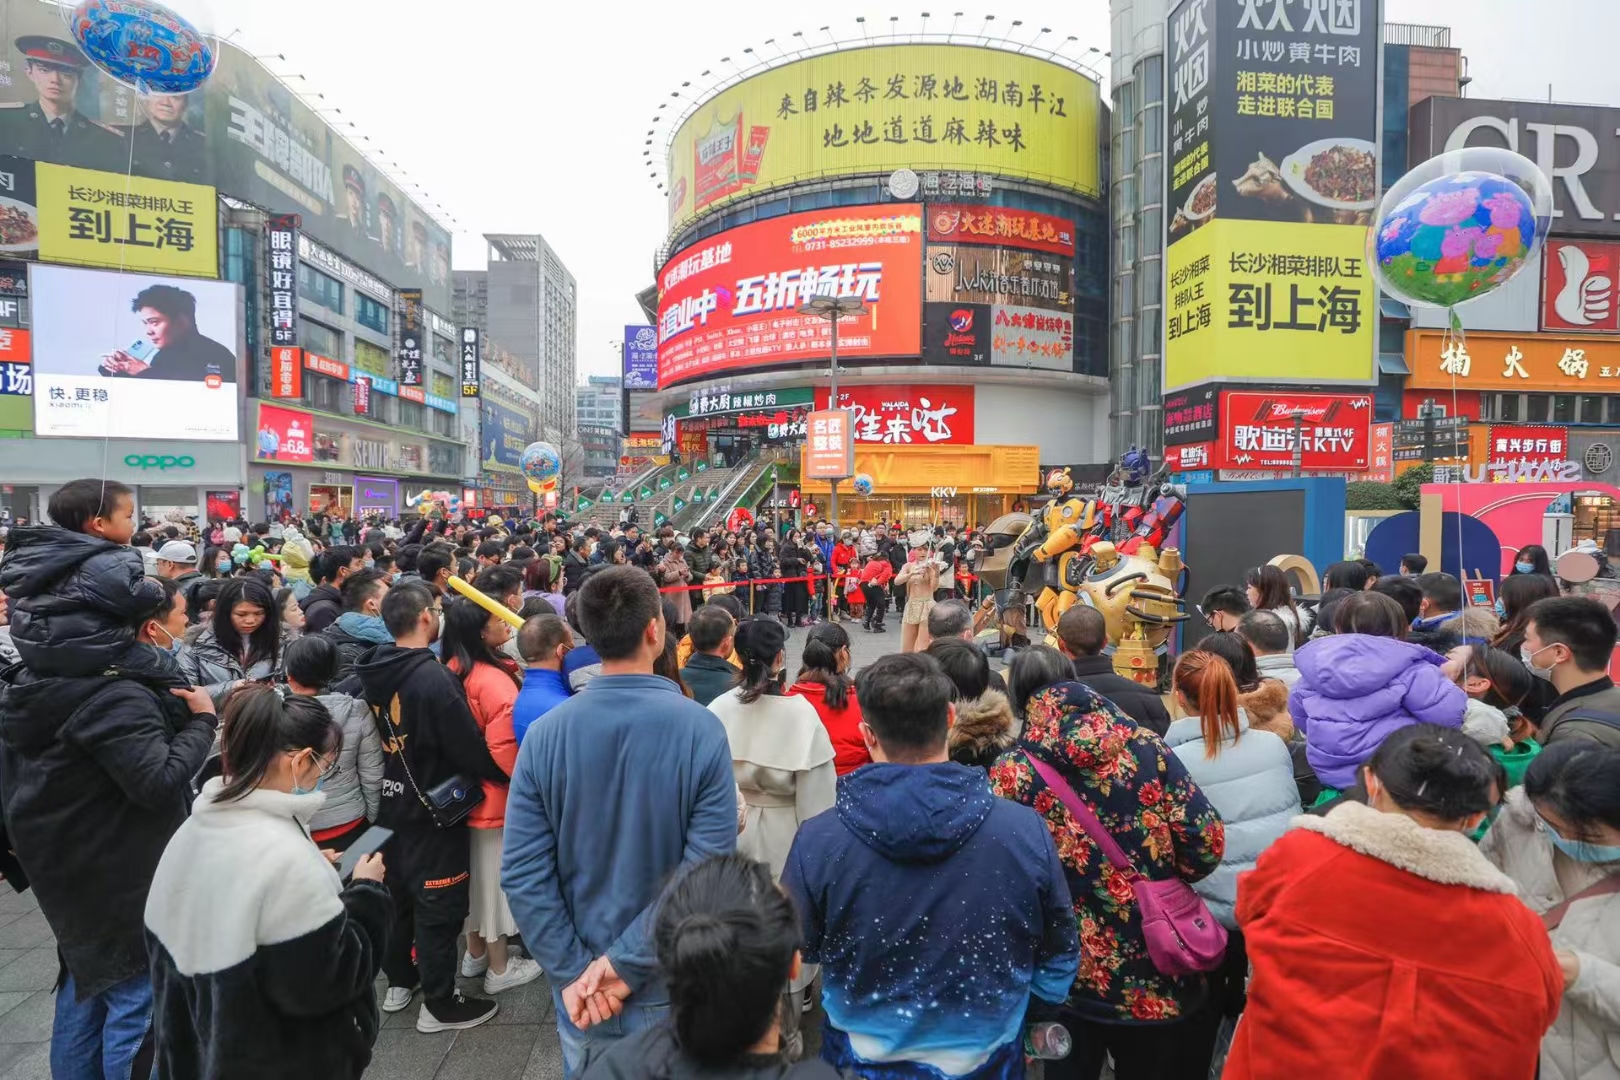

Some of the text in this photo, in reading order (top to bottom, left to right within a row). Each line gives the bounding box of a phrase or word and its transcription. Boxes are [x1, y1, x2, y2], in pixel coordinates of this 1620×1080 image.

[1236, 0, 1361, 36] 炊烟
[1236, 38, 1361, 67] 小炒黄牛肉
[776, 74, 1068, 119] 来自辣条发源地湖南平江
[1236, 70, 1335, 97] 湘菜的代表
[1236, 95, 1334, 120] 走进联合国
[822, 115, 1027, 153] 地地道道麻辣味
[1442, 115, 1620, 221] CR
[68, 184, 193, 215] 长沙湘菜排队王
[68, 206, 194, 251] 到上海
[1170, 254, 1210, 289] 长沙湘菜
[1228, 251, 1362, 278] 长沙湘菜排队王
[271, 231, 292, 328] 眼镜好宜得
[732, 262, 882, 317] 五折畅玩
[1173, 281, 1205, 310] 排队王
[1228, 282, 1361, 334] 到上海
[275, 330, 292, 341] 5F
[1168, 302, 1211, 341] 到上海
[1440, 342, 1589, 379] 楠火锅
[0, 368, 31, 394] 场
[463, 385, 478, 395] 5F
[700, 393, 776, 413] 费大厨 辣椒炒肉
[1271, 403, 1326, 415] Budweiser
[813, 418, 841, 434] 名匠
[1234, 425, 1311, 451] 歌迪乐
[1343, 428, 1354, 438] 4F
[354, 440, 388, 469] SEMIR
[813, 436, 842, 451] 整装
[1314, 437, 1354, 453] KTV
[1496, 438, 1562, 453] 黄兴步行街
[931, 486, 957, 498] KKV
